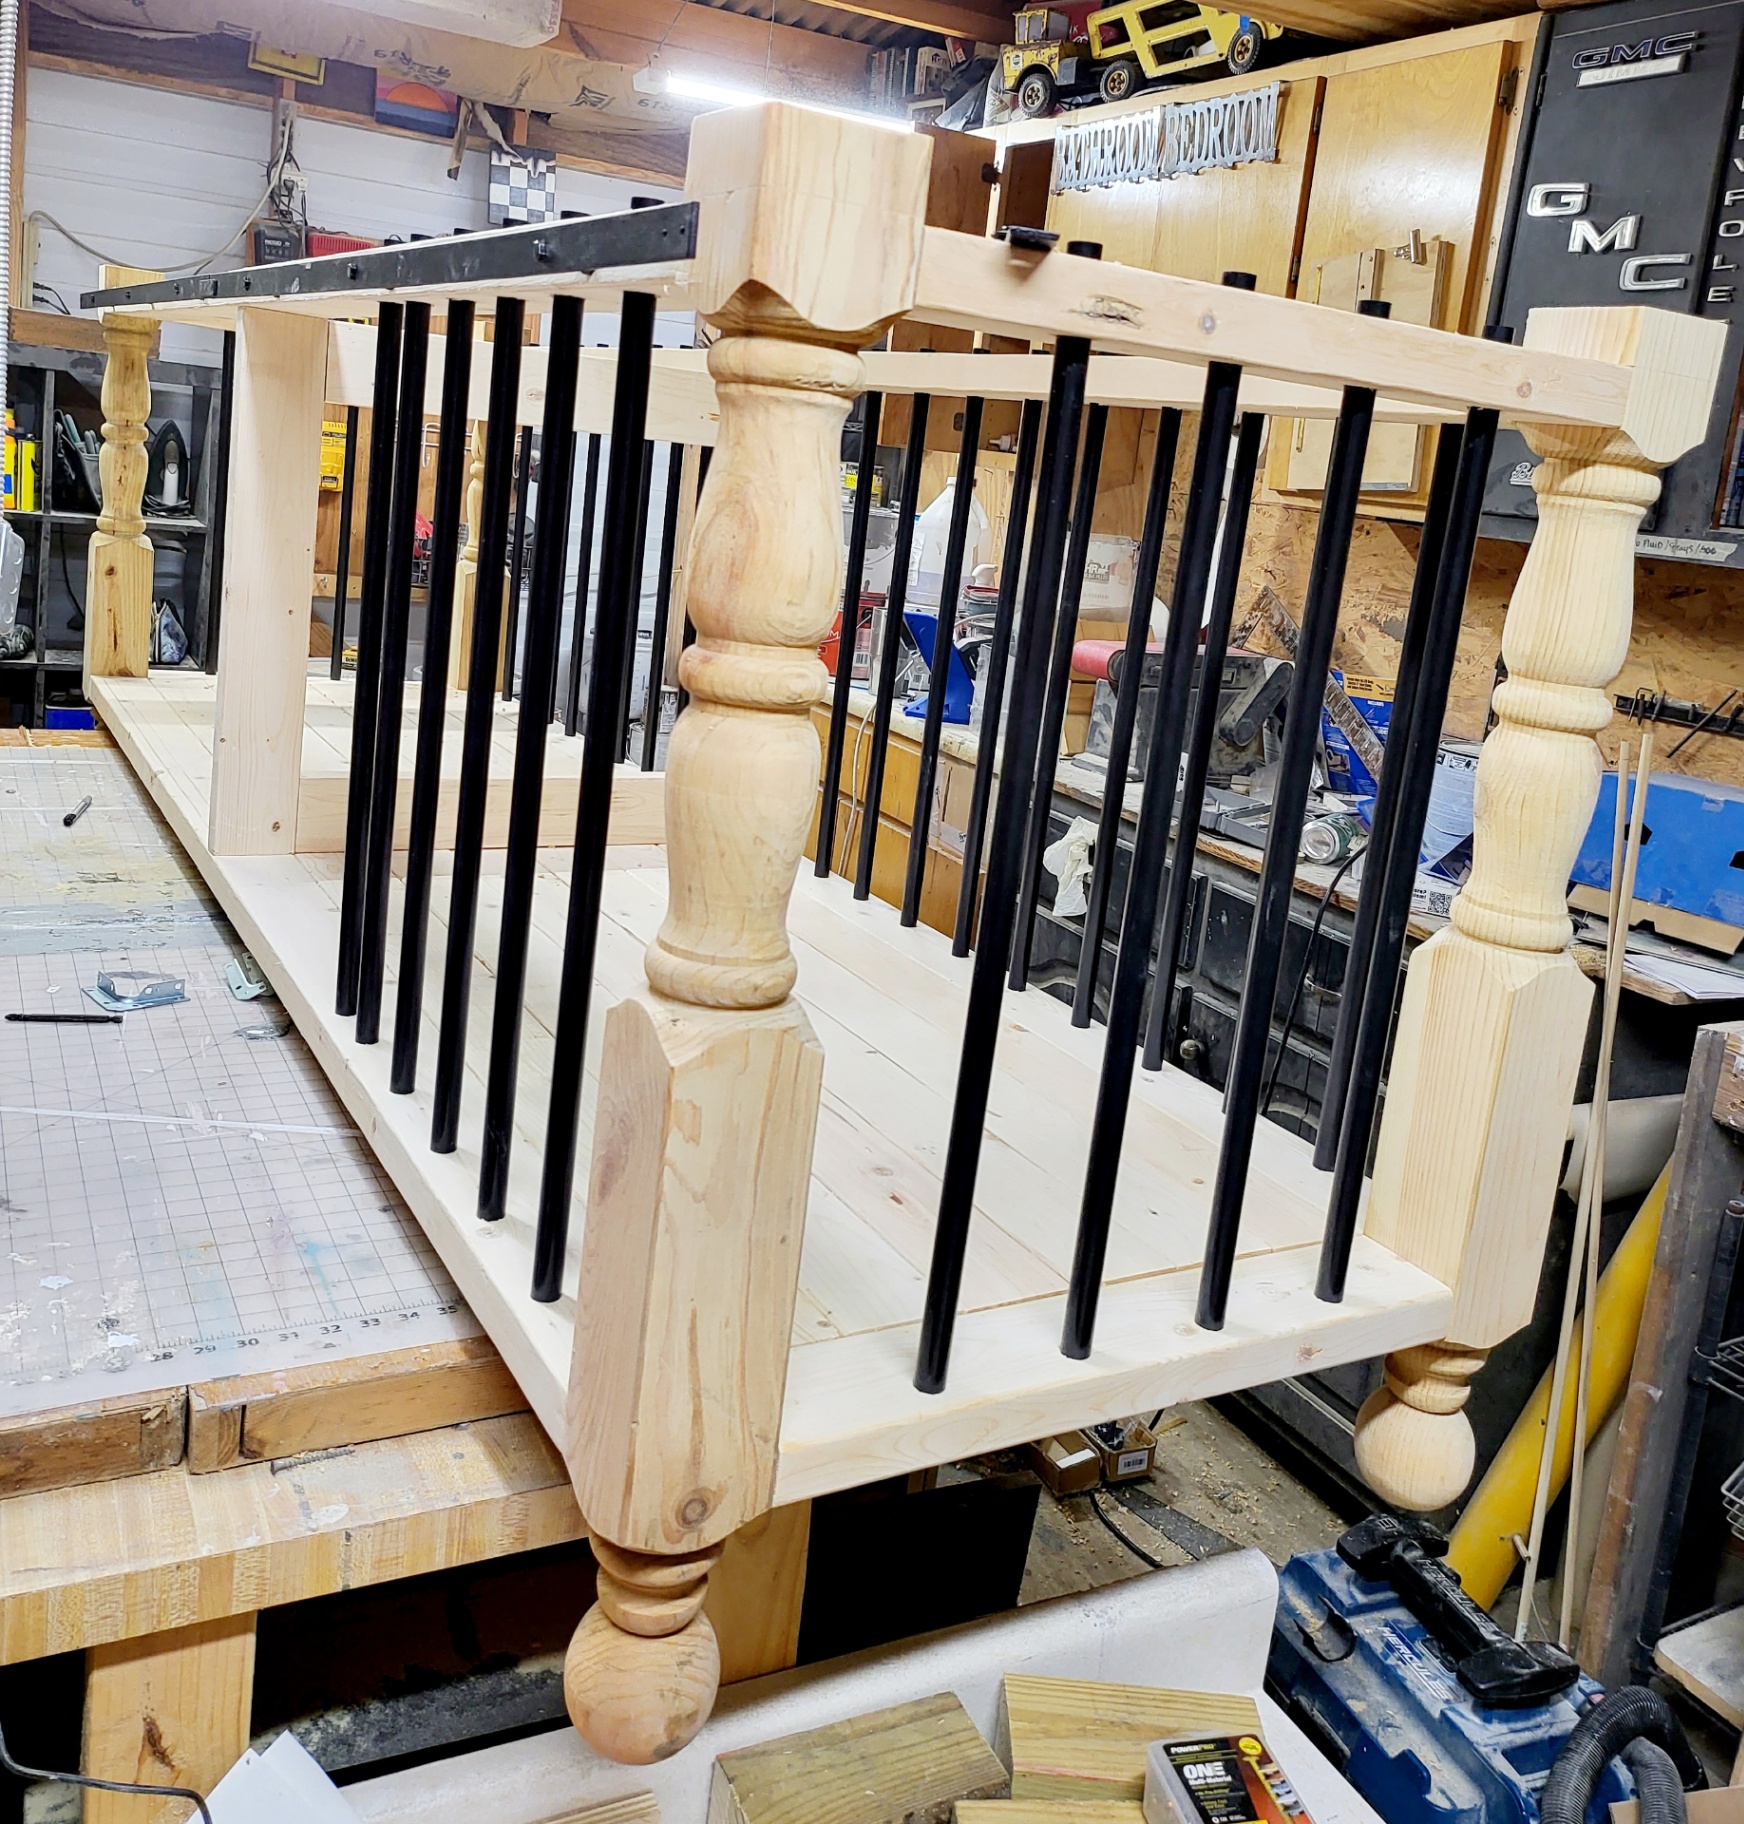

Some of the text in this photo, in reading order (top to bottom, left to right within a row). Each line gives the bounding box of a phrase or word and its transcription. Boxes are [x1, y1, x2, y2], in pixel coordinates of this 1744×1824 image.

[1572, 31, 1699, 69] GMC
[1057, 108, 1162, 188] BATHROOM
[1165, 90, 1277, 169] BEDROOM
[236, 1337, 260, 1349] 30
[318, 1324, 343, 1335] 32
[359, 1317, 382, 1329] 33
[398, 1310, 421, 1322] 34
[436, 1304, 459, 1316] 35
[1378, 1626, 1453, 1701] HERCULES
[1182, 1761, 1226, 1779] ONE
